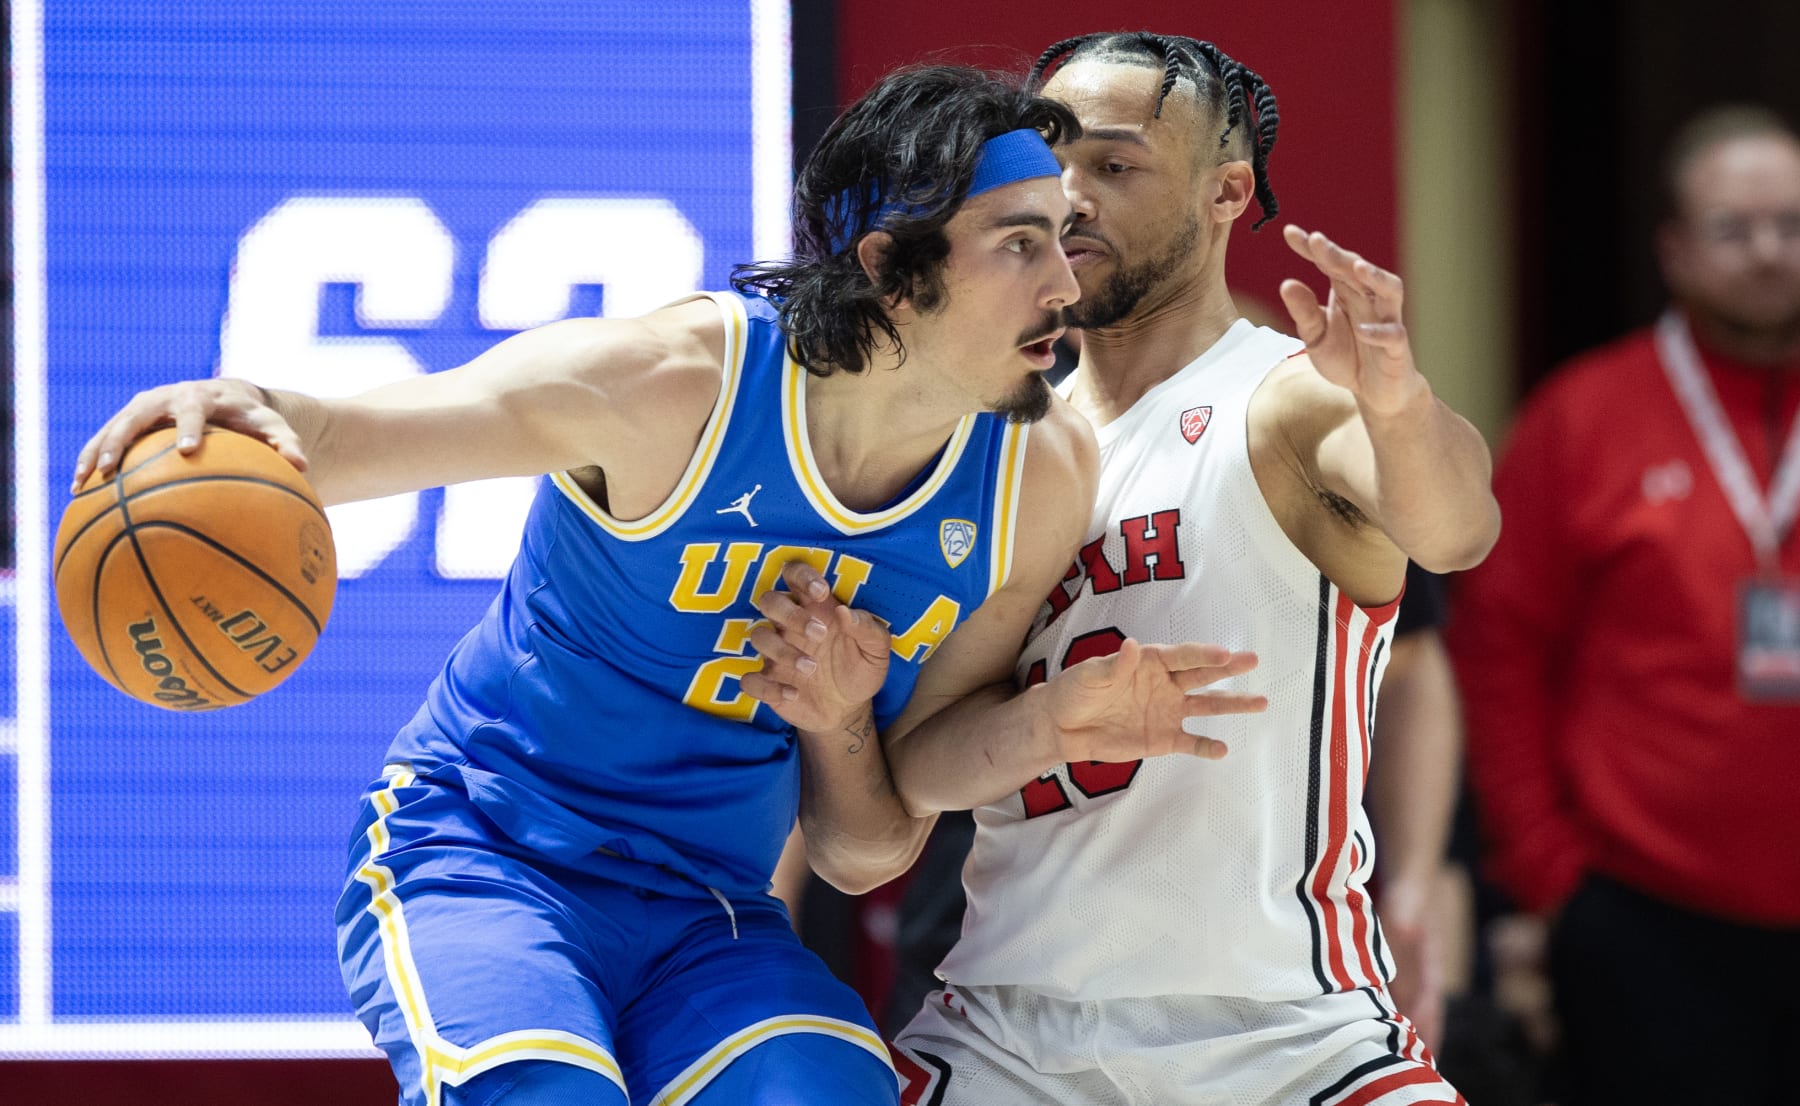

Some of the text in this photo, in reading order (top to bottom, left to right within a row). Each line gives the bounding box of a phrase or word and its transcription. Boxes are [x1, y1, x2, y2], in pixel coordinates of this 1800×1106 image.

[1186, 421, 1203, 437] 12
[947, 540, 964, 556] 12
[1023, 508, 1185, 648] AH
[219, 609, 297, 674] EVO
